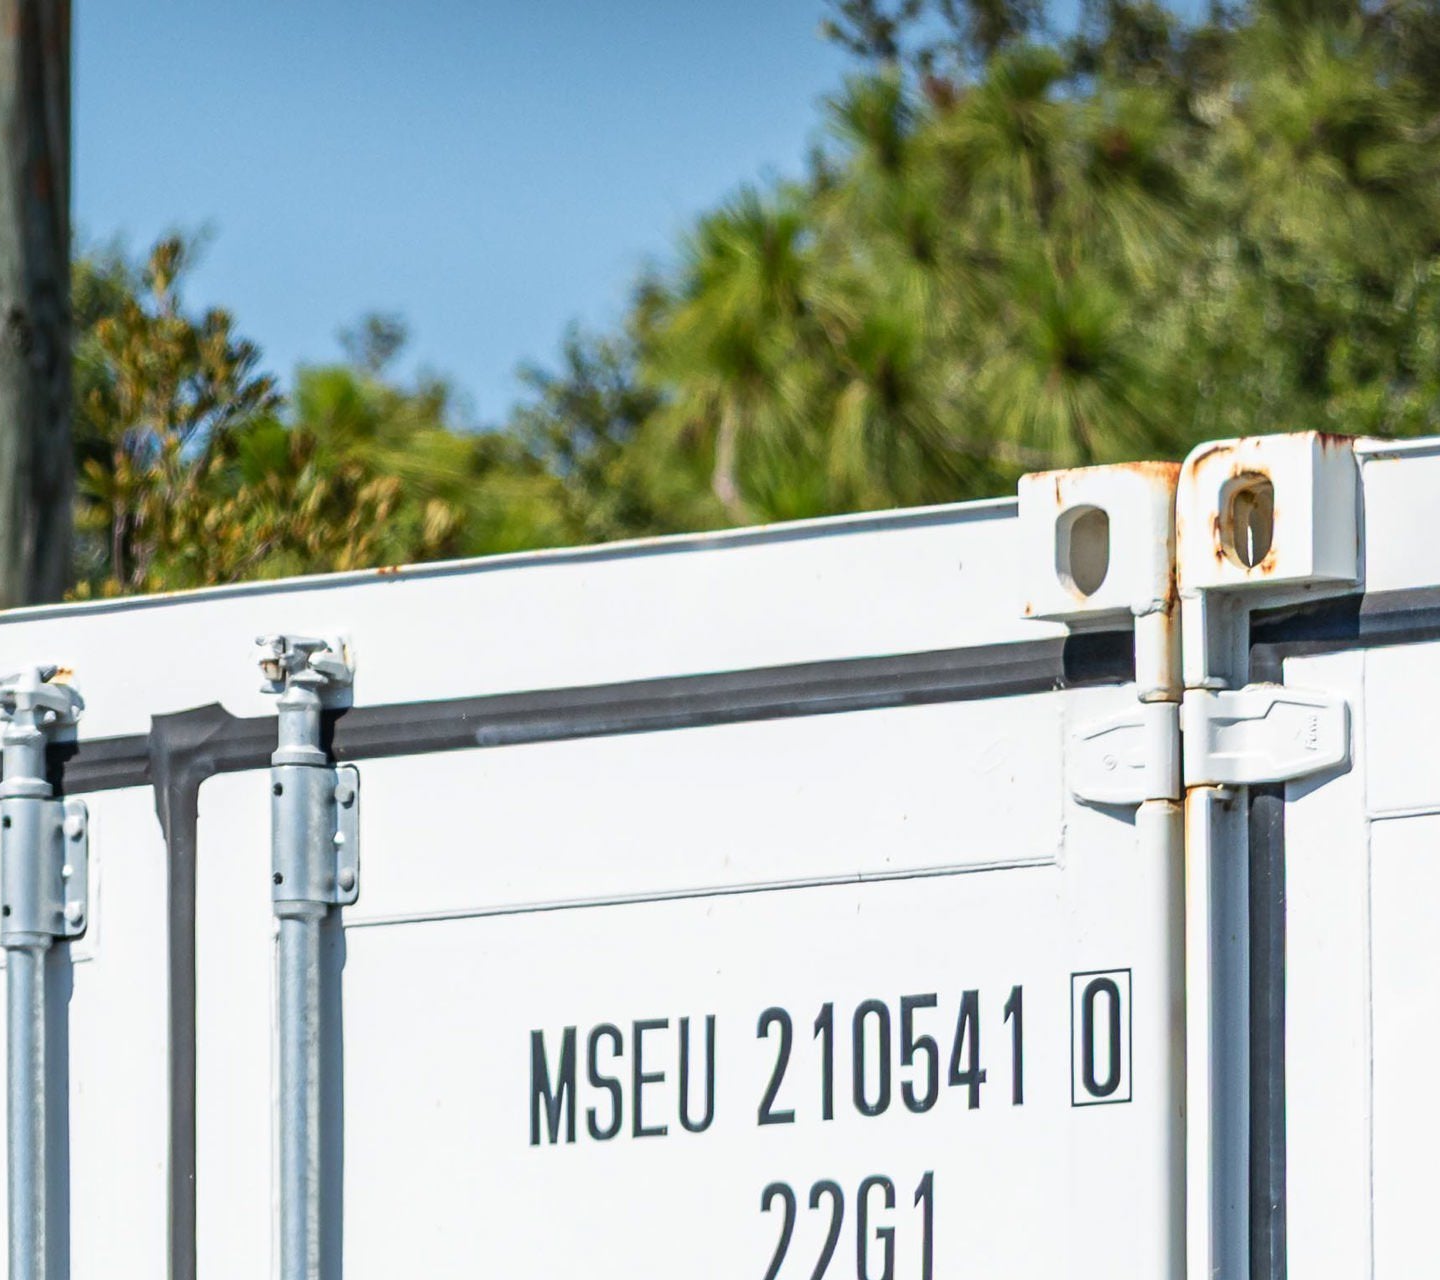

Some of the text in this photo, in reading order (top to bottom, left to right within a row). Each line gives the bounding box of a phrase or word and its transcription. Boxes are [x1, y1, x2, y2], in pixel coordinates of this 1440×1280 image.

[529, 977, 1120, 1146] MSEU 210541 0
